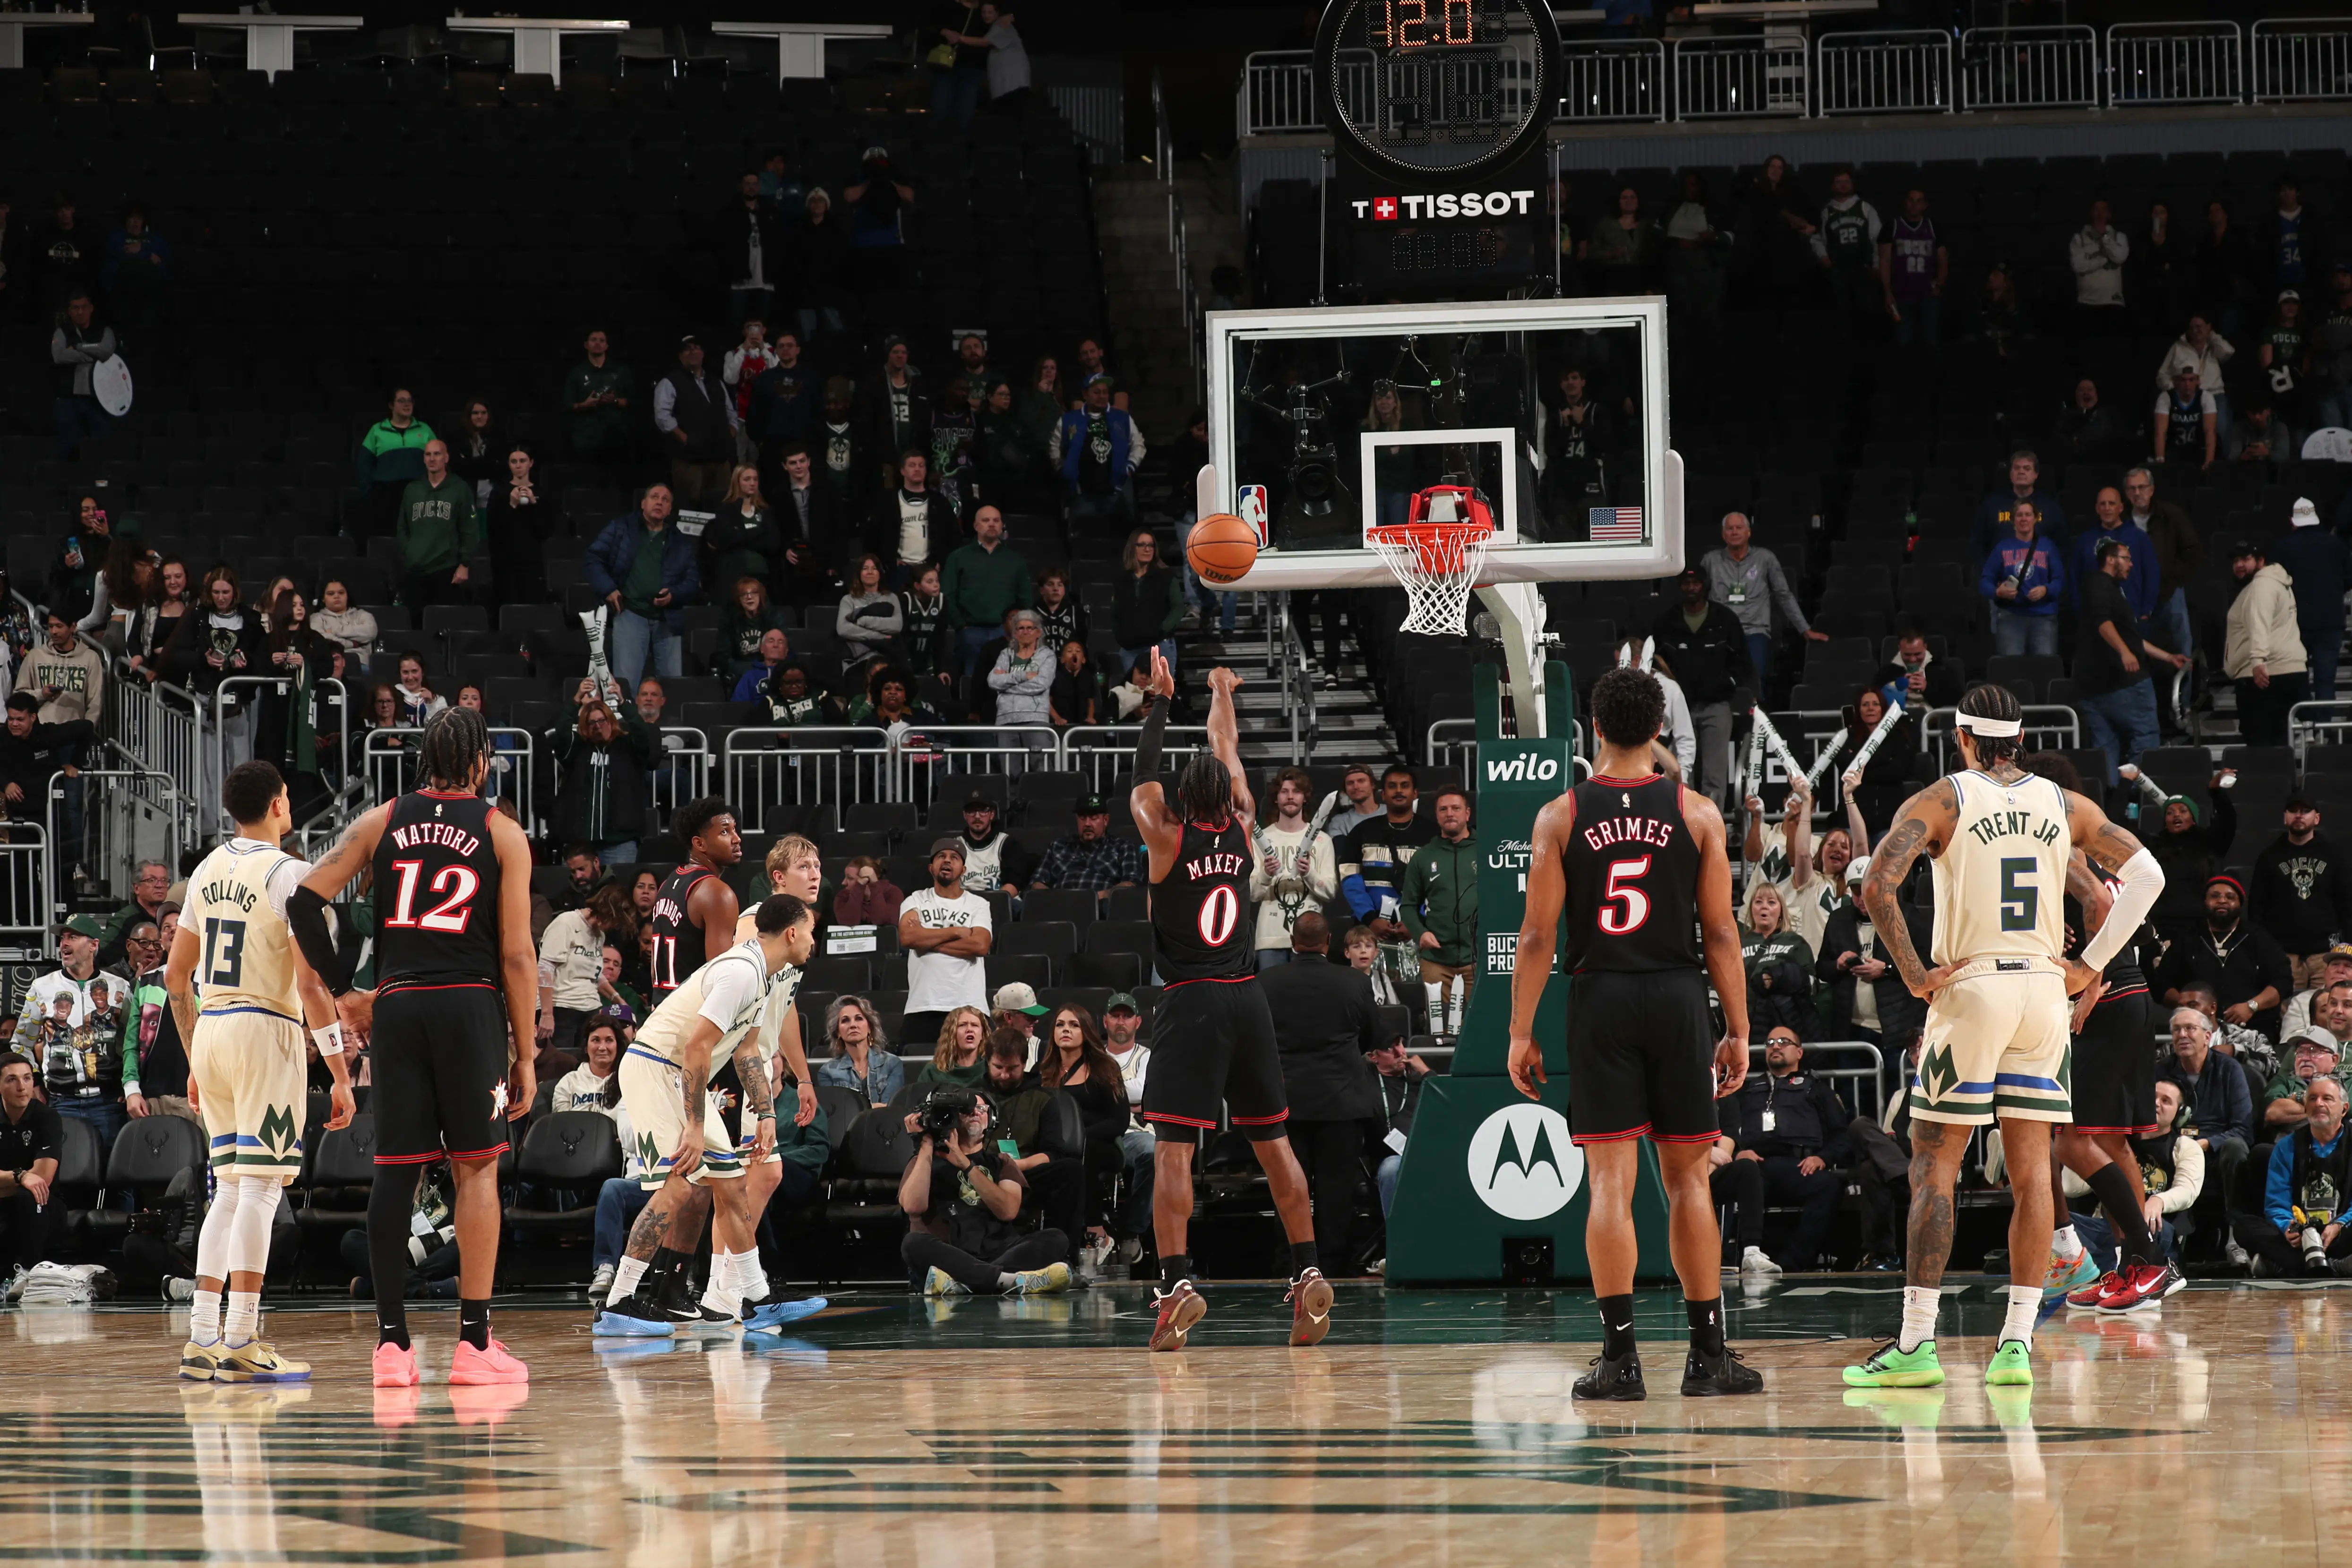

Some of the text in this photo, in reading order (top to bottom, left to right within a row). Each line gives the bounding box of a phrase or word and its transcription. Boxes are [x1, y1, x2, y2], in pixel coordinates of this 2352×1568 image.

[1385, 0, 1472, 46] 12.0
[1402, 190, 1535, 219] TISSOT
[1839, 227, 1858, 244] 22
[2283, 247, 2302, 264] 34
[1566, 440, 1585, 458] 34
[412, 500, 452, 522] BUCKS
[585, 626, 599, 642] FEAR
[1044, 625, 1072, 639] UCKS
[593, 652, 606, 667] DEER
[1487, 753, 1558, 782] wilo
[1584, 817, 1674, 852] GRIMES
[1968, 811, 2060, 847] TRENT JR
[392, 822, 480, 857] WATFORD
[1497, 839, 1532, 853] Miche
[1185, 852, 1244, 881] MAXEY
[1488, 854, 1533, 869] ULT
[2278, 857, 2327, 875] BUCKS
[983, 865, 1000, 878] City
[202, 879, 258, 913] ROLLINS
[385, 859, 481, 934] 12
[1597, 853, 1652, 936] 5
[2000, 857, 2043, 932] 5
[921, 908, 970, 925] BUCKS
[1197, 883, 1240, 947] 0
[204, 917, 246, 987] 13
[1487, 936, 1519, 953] BUC
[652, 933, 681, 990] 11
[1758, 954, 1777, 963] ucks
[1430, 1000, 1443, 1019] FEAR
[97, 1043, 108, 1056] 34
[64, 1056, 74, 1070] 43
[429, 1214, 443, 1225] UCKS
